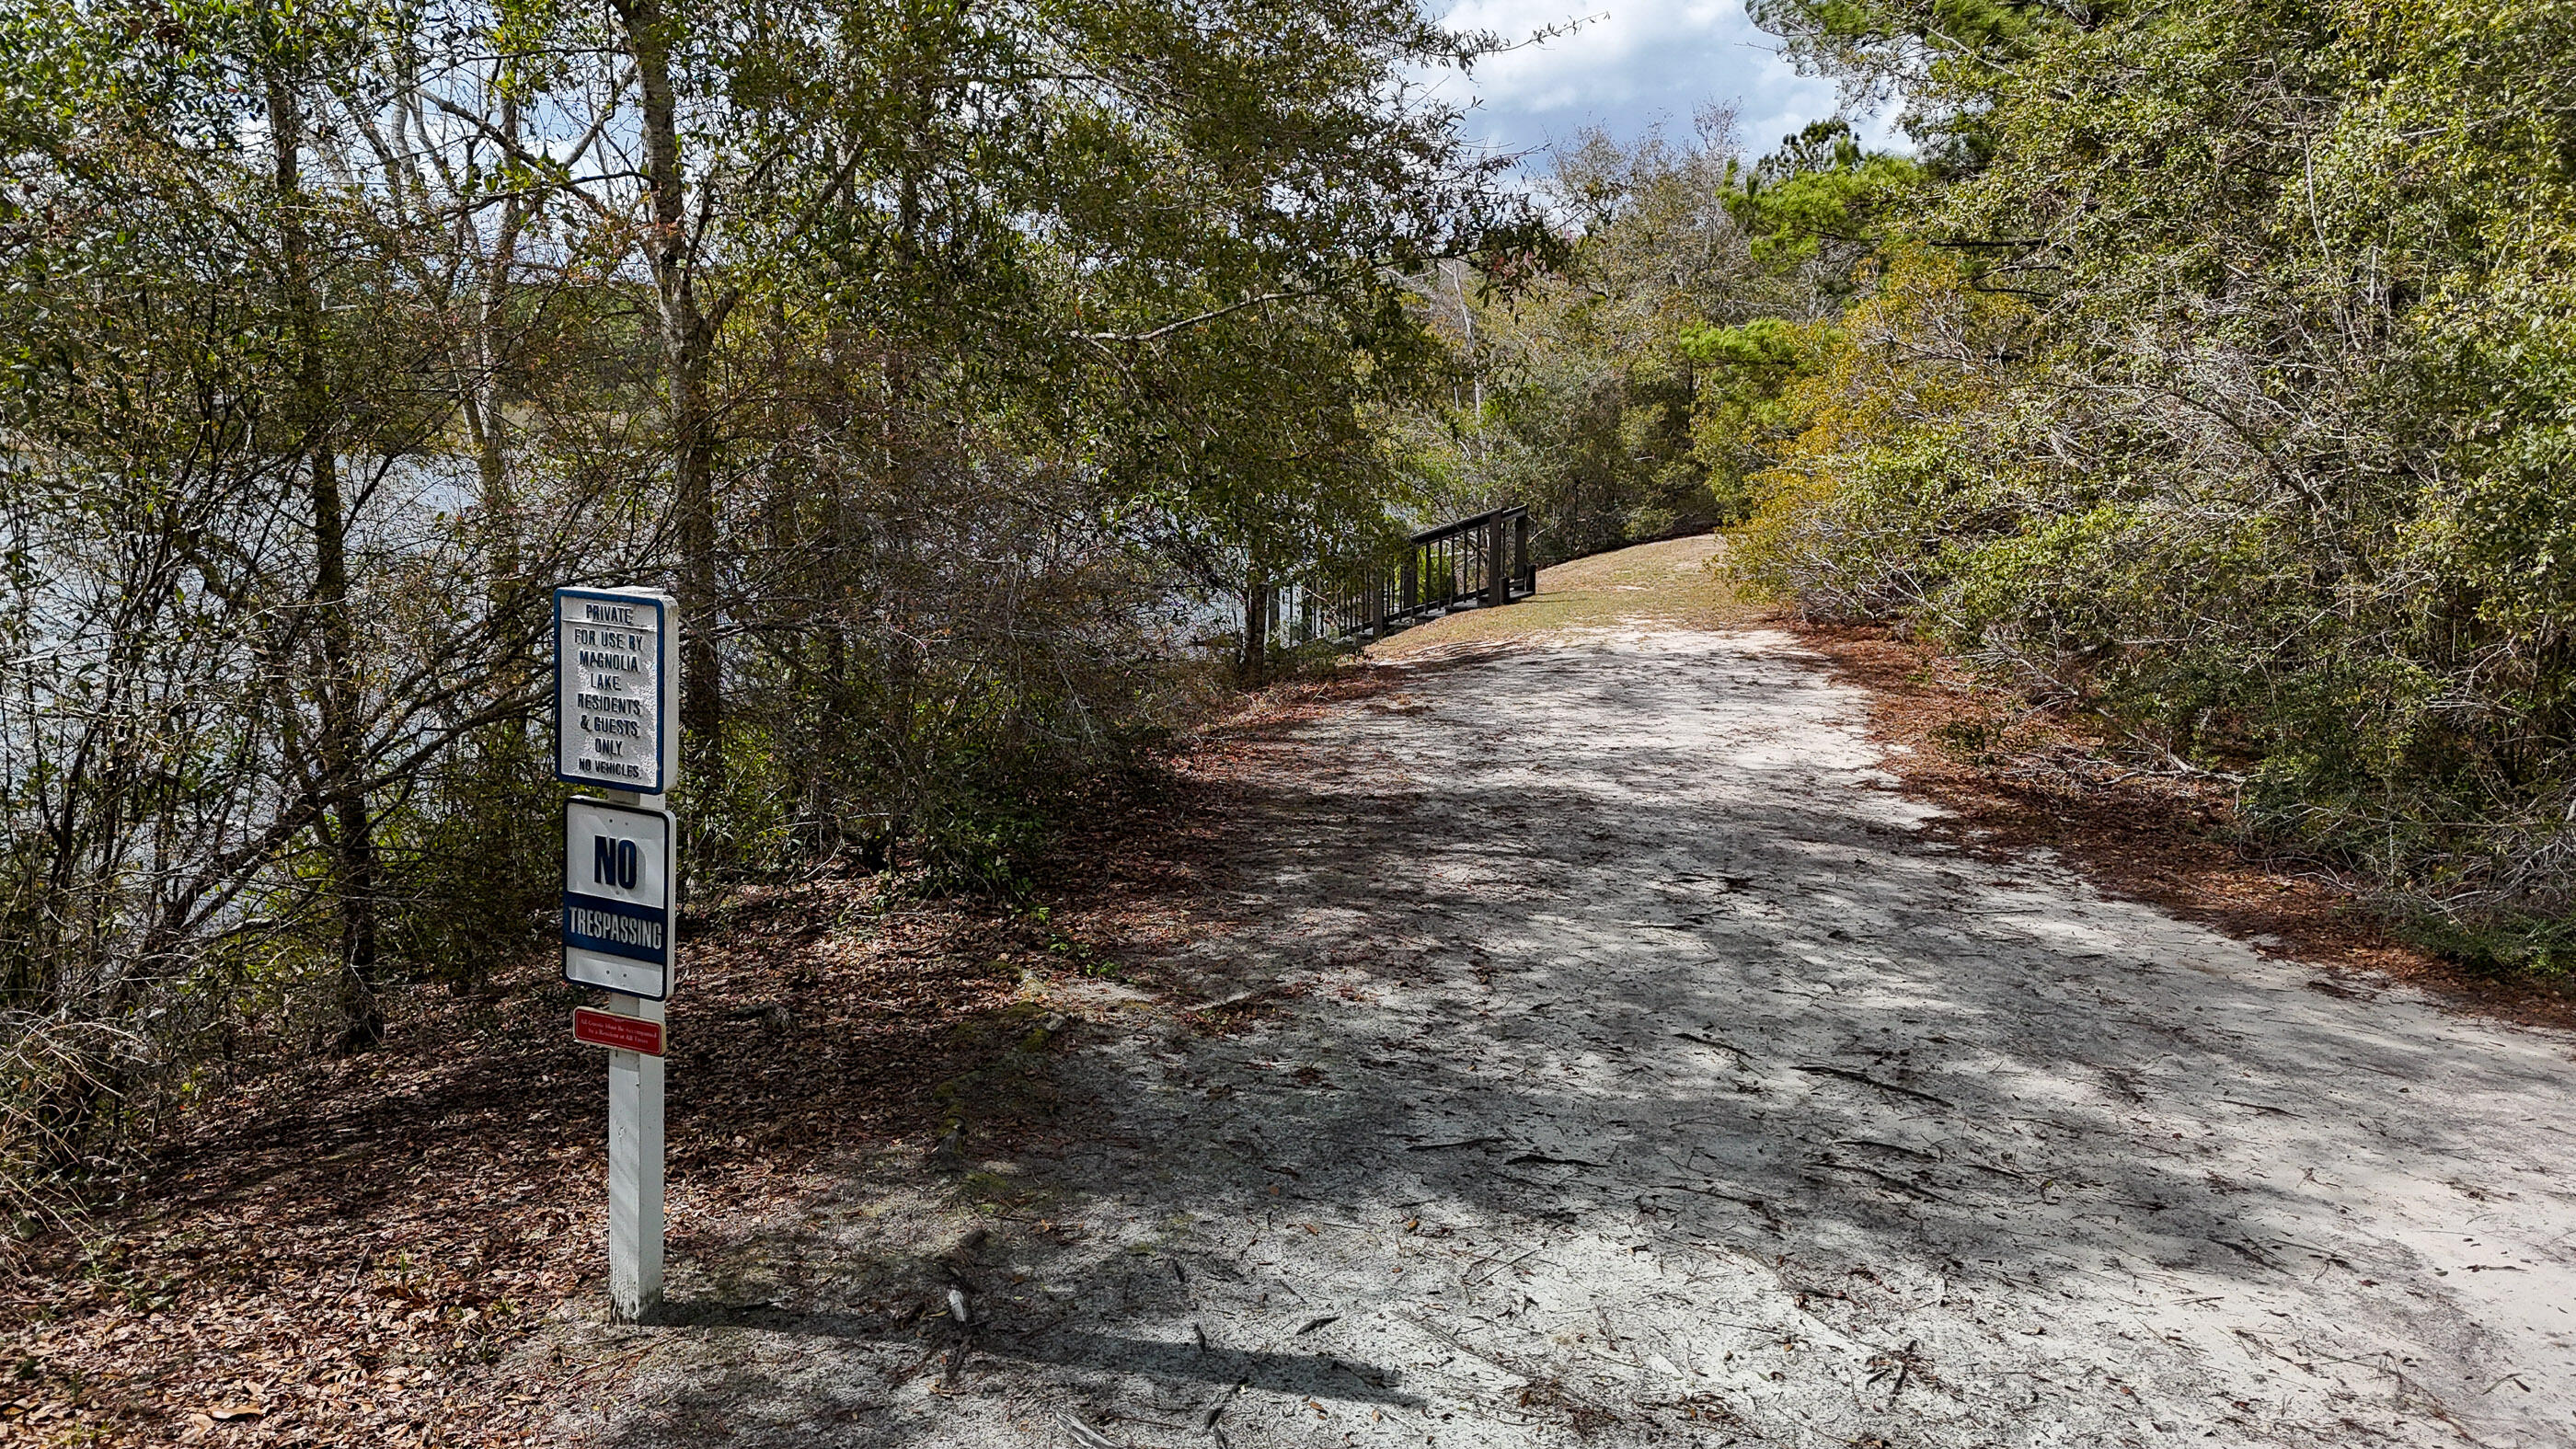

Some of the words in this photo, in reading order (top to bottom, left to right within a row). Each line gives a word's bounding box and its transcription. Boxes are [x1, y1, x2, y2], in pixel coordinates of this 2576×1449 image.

[586, 604, 633, 624] PRIVATE
[575, 628, 595, 645] FOR
[601, 631, 624, 649] USE
[628, 634, 643, 651] BY
[580, 650, 638, 673] MAGNOLIA
[591, 673, 621, 690] LAKE
[578, 693, 641, 716] RESIDENTS
[581, 715, 590, 730] &
[594, 716, 638, 737] GUESTS
[595, 738, 623, 755] ONLY
[579, 757, 592, 771] NO
[595, 760, 639, 778] VEHICLES
[594, 834, 638, 889] NO
[569, 906, 662, 949] TRESPASSING
